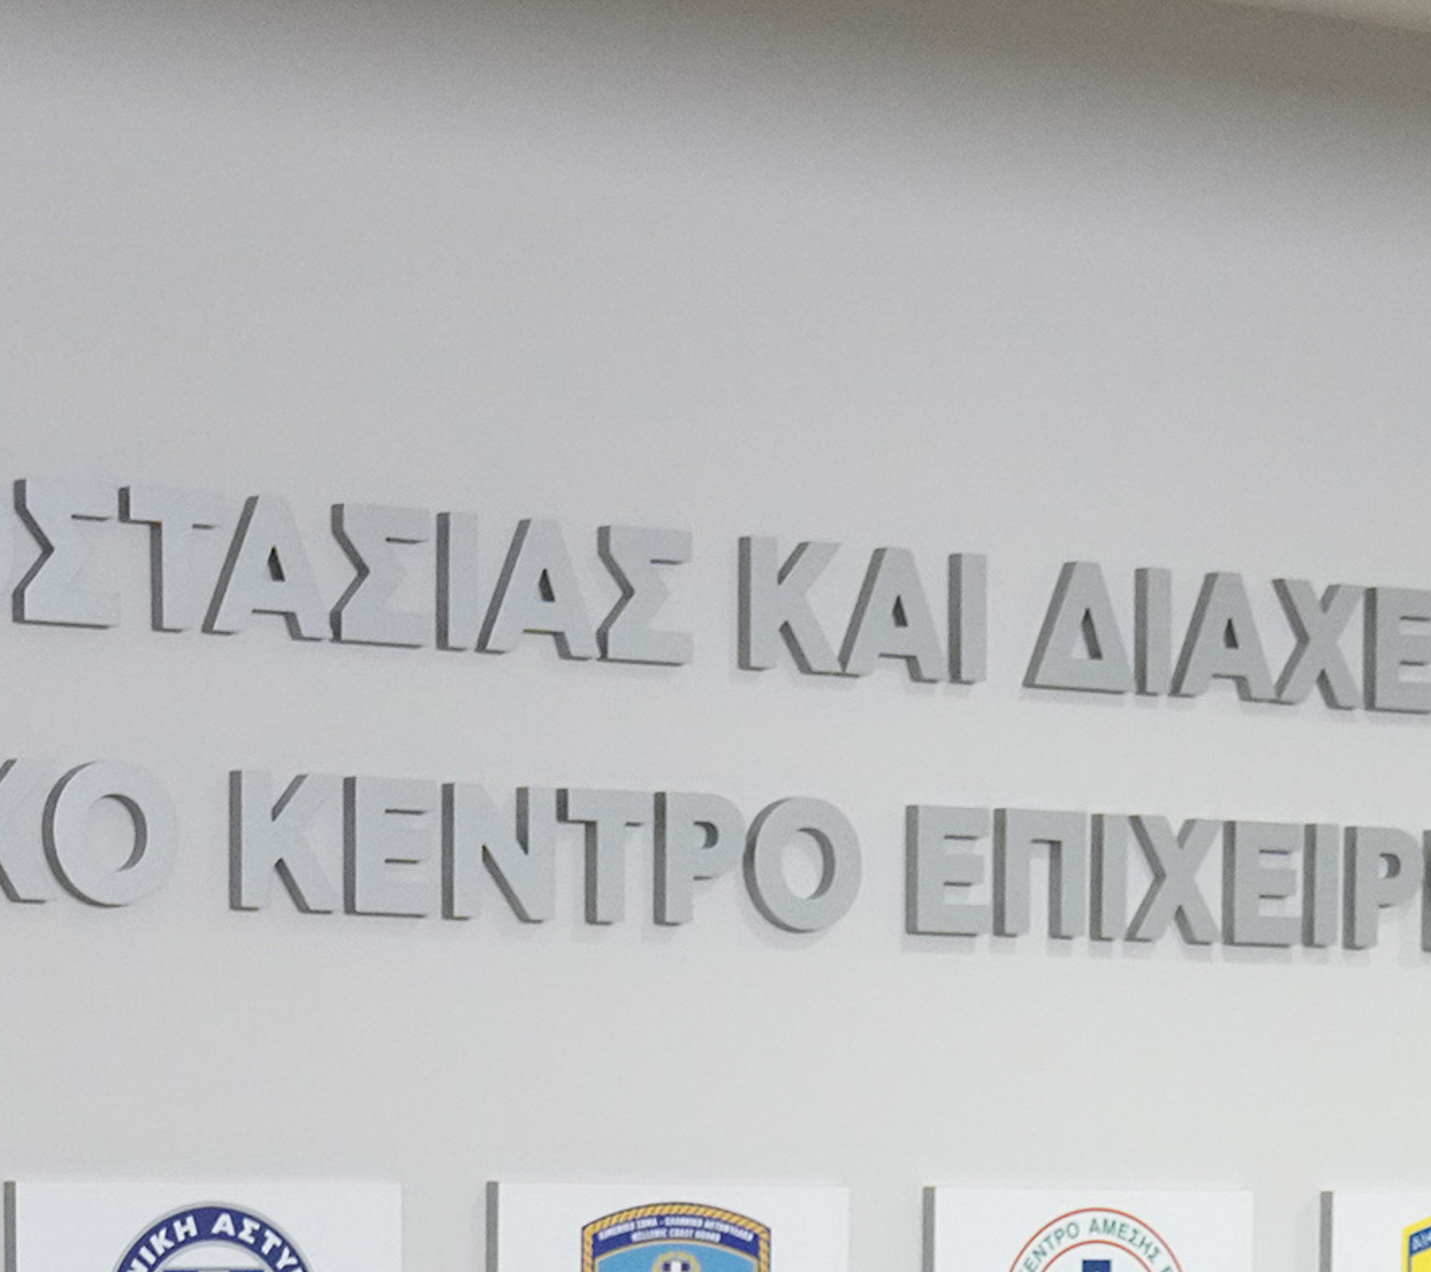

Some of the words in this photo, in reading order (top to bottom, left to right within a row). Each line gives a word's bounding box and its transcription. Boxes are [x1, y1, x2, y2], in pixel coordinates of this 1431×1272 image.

[736, 535, 988, 688] ΚΑΙ
[228, 767, 862, 932] ΚΕΝΤΡΟ
[1088, 1217, 1165, 1265] ΑΜΕΣΗΣ
